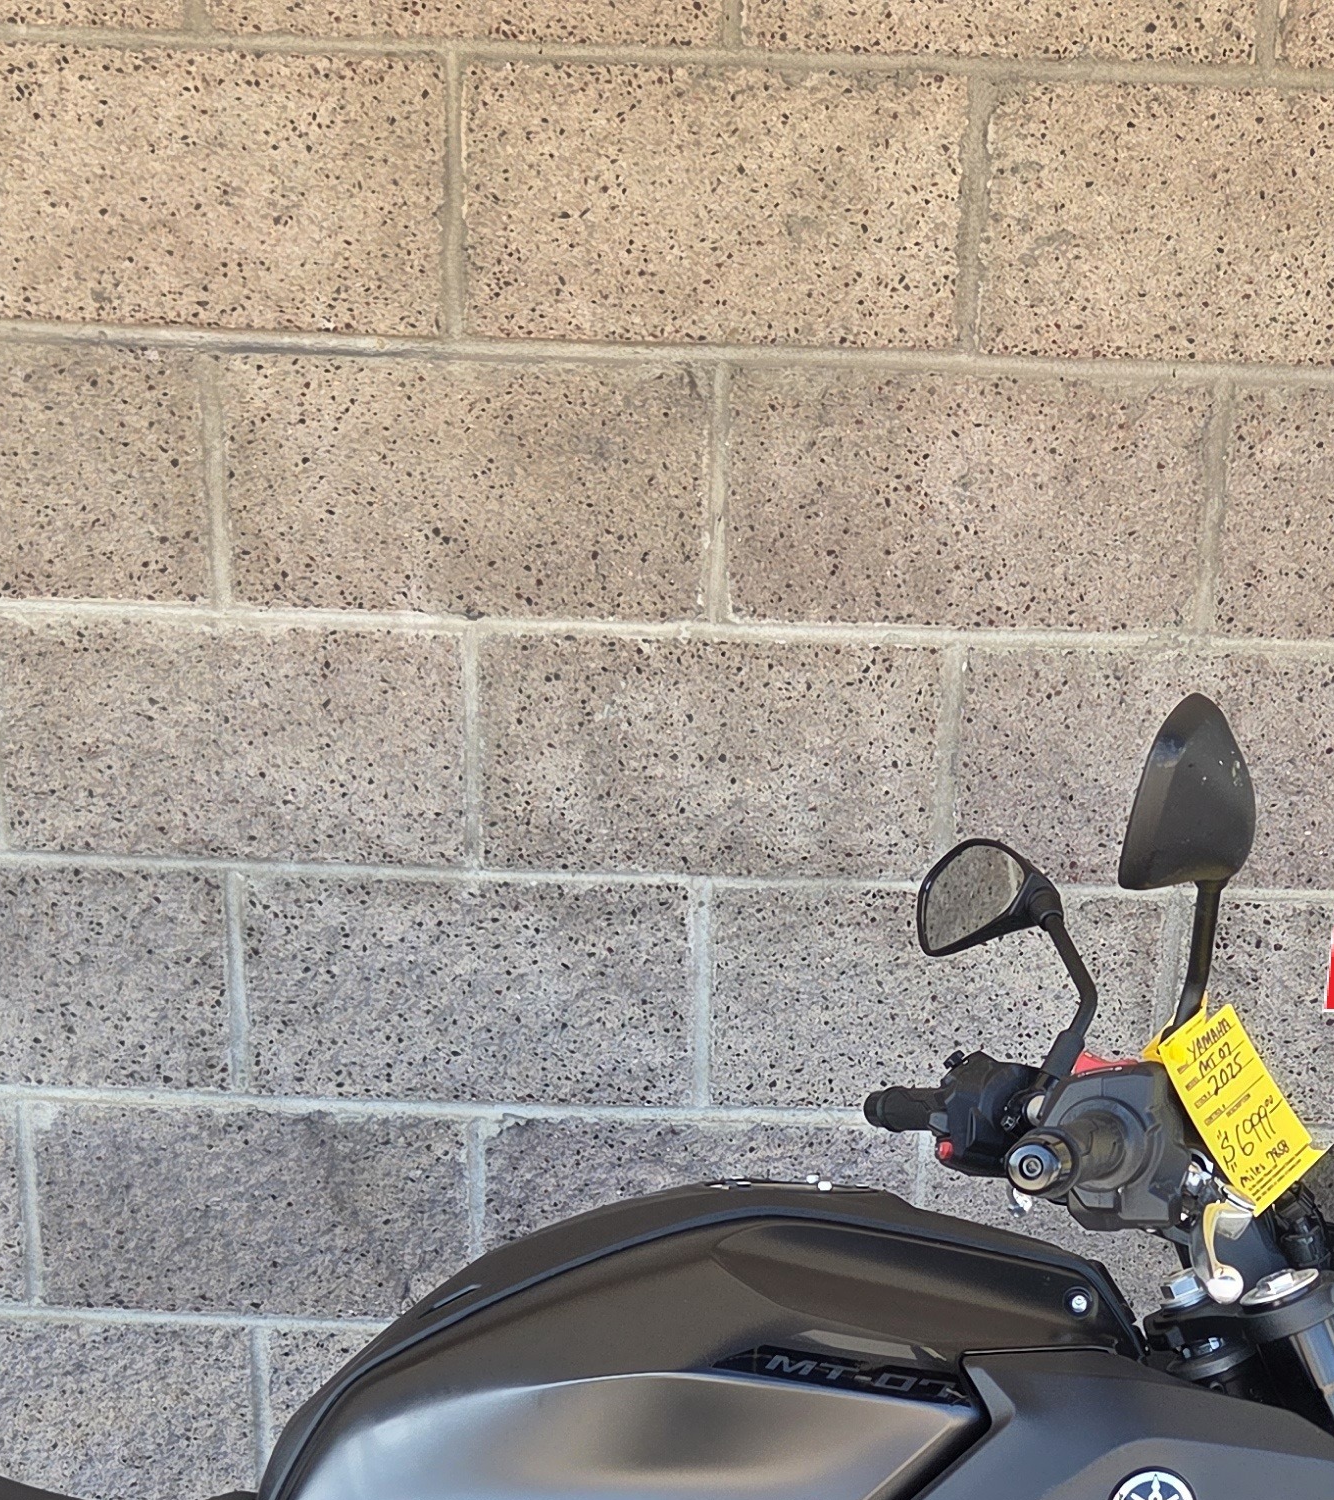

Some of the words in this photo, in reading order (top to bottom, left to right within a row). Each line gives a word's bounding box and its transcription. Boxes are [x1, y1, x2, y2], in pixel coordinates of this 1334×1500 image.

[1187, 1018, 1232, 1061] YAMAHA
[1207, 1051, 1243, 1096] 2025
[765, 1354, 956, 1399] MT-07
